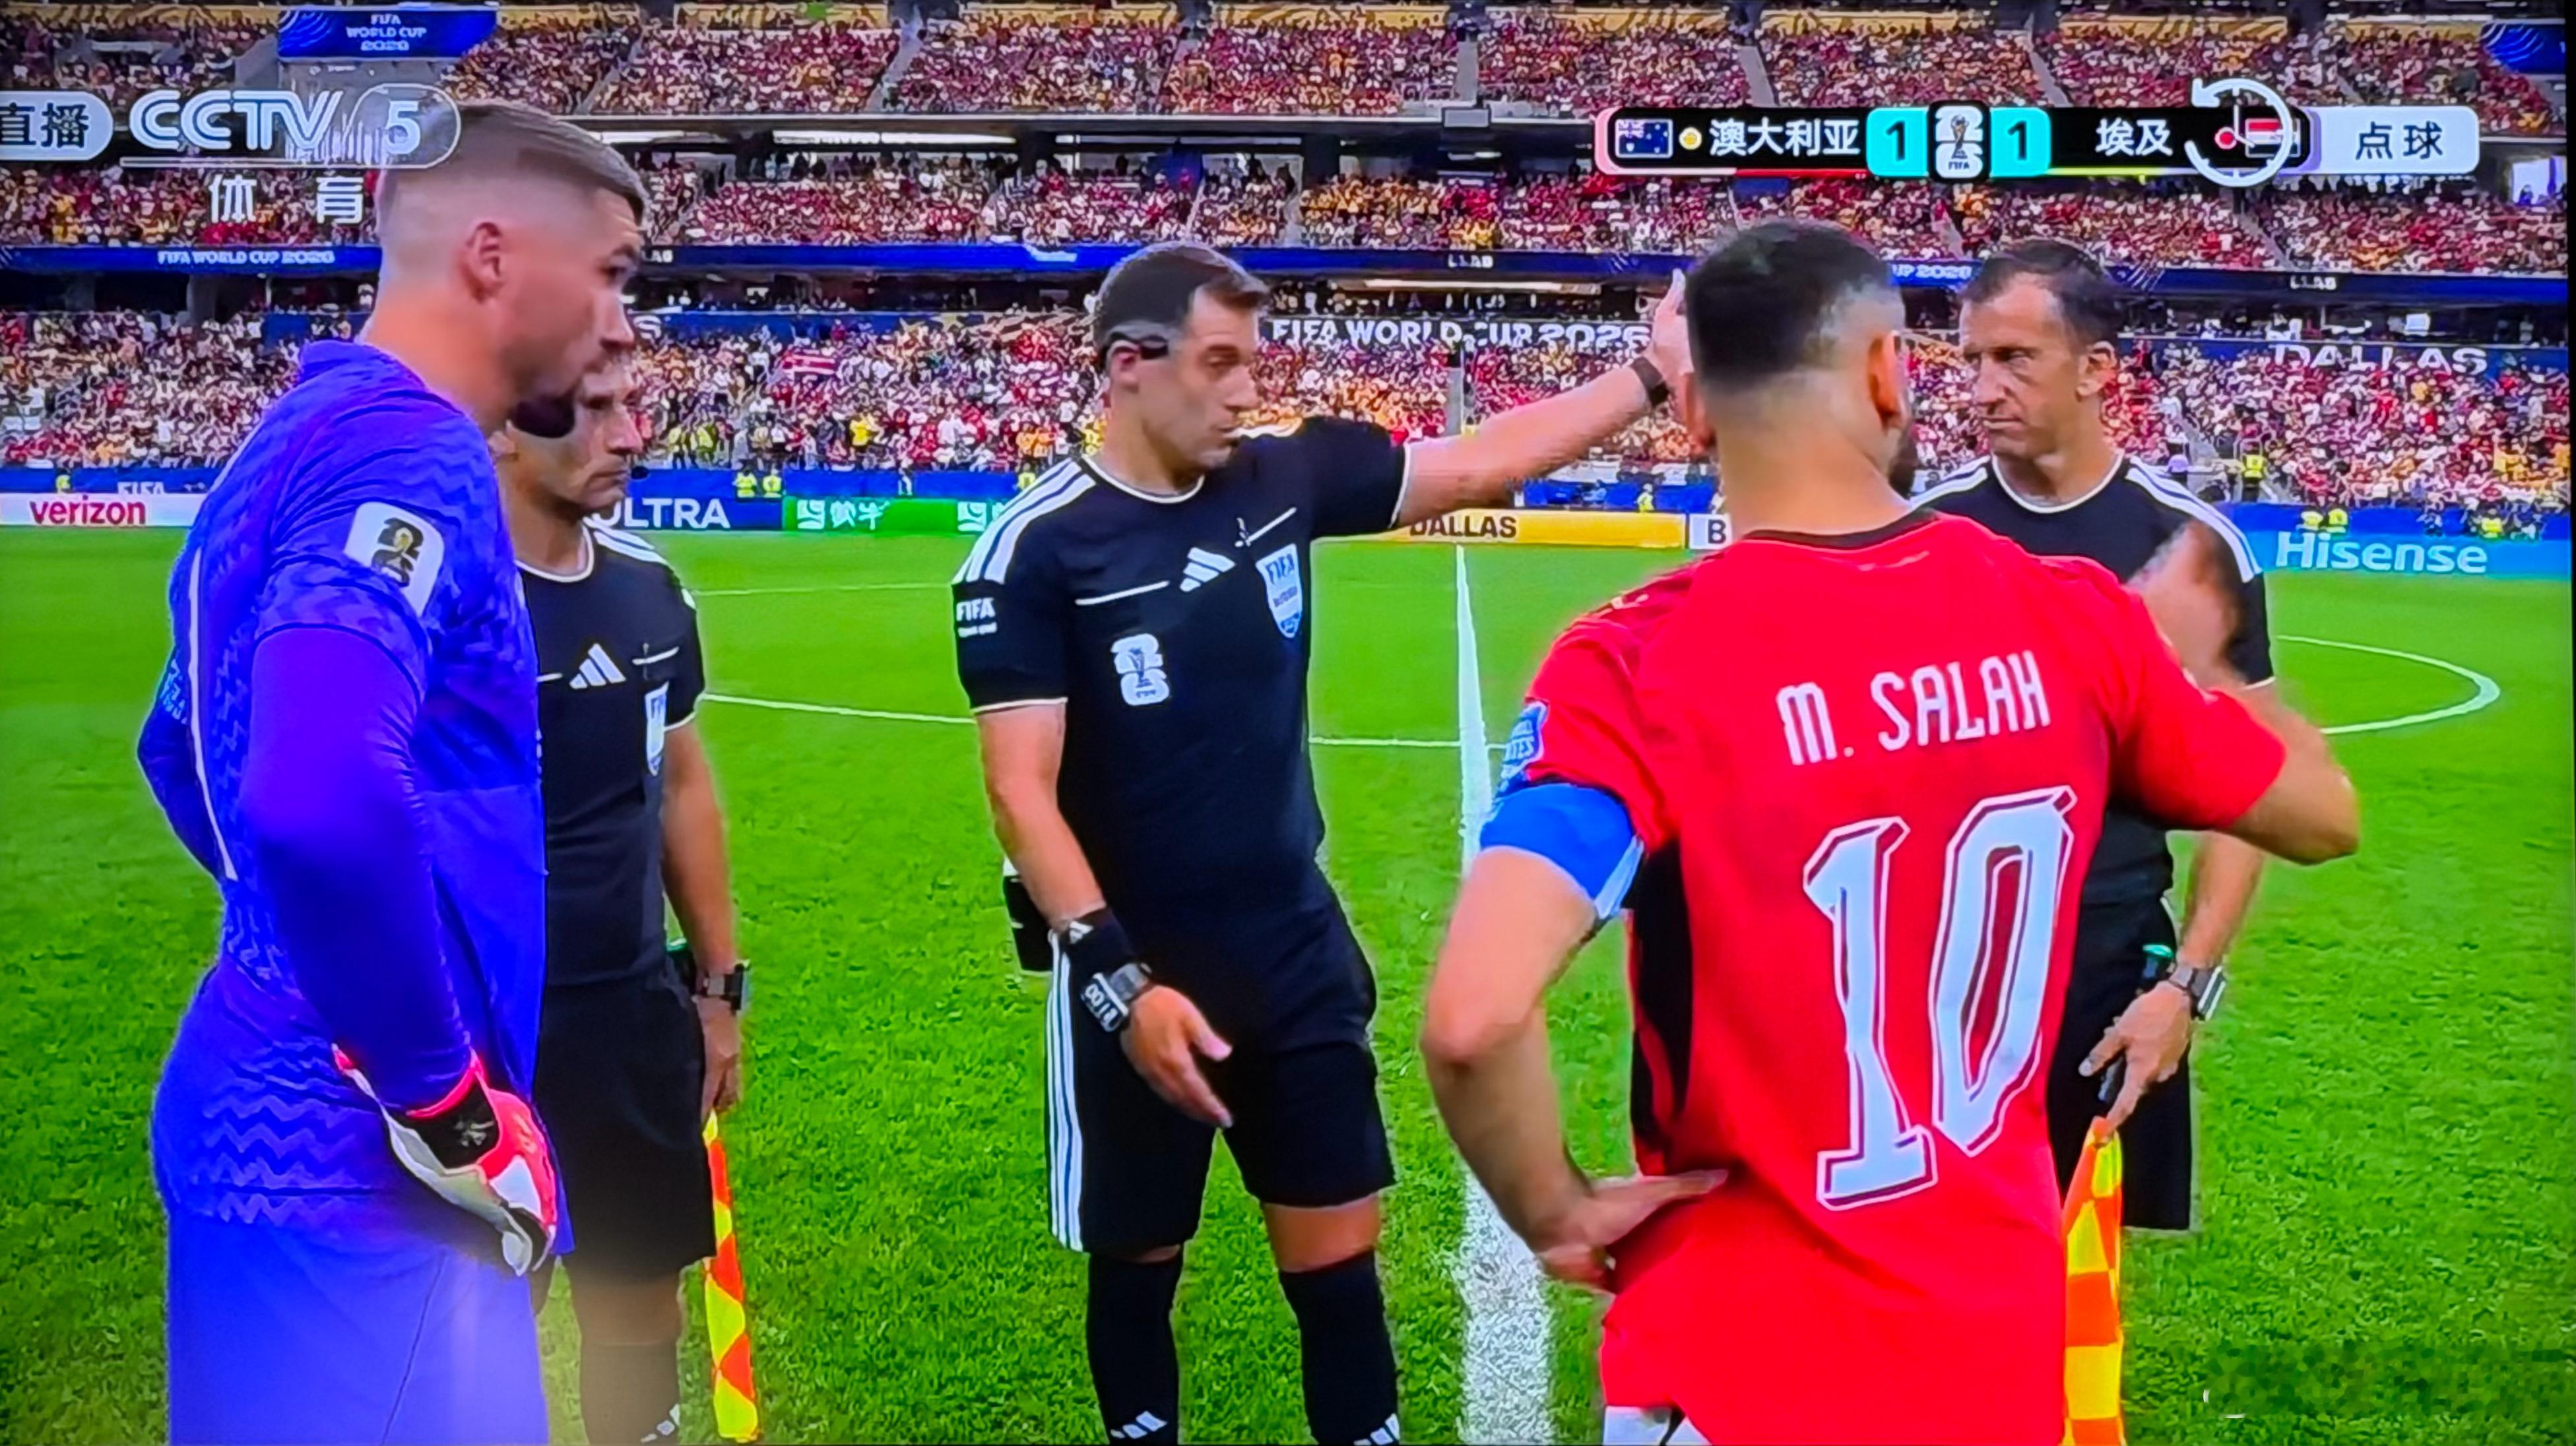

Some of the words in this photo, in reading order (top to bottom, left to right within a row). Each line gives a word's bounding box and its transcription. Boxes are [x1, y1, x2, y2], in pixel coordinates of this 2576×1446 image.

[346, 26, 396, 38] WORLD
[399, 26, 427, 39] CUP
[131, 90, 342, 150] CCTV
[384, 100, 422, 155] 5
[1709, 117, 1860, 156] 澳大利亚
[1884, 121, 1906, 162] 1
[2008, 121, 2029, 162] 1
[2095, 118, 2173, 158] 埃及
[2356, 122, 2443, 160] 点球
[208, 174, 364, 224] 体育
[158, 251, 191, 264] FIFA
[193, 251, 247, 264] WORLD
[249, 251, 280, 264] CUP
[1272, 319, 1337, 345] FIFA
[30, 495, 146, 524] verizon
[2275, 532, 2489, 573] Hisense
[956, 597, 996, 621] FIFA
[1776, 682, 1855, 766] M.
[1871, 650, 2051, 751] SALAH
[1802, 785, 2078, 1211] 10
